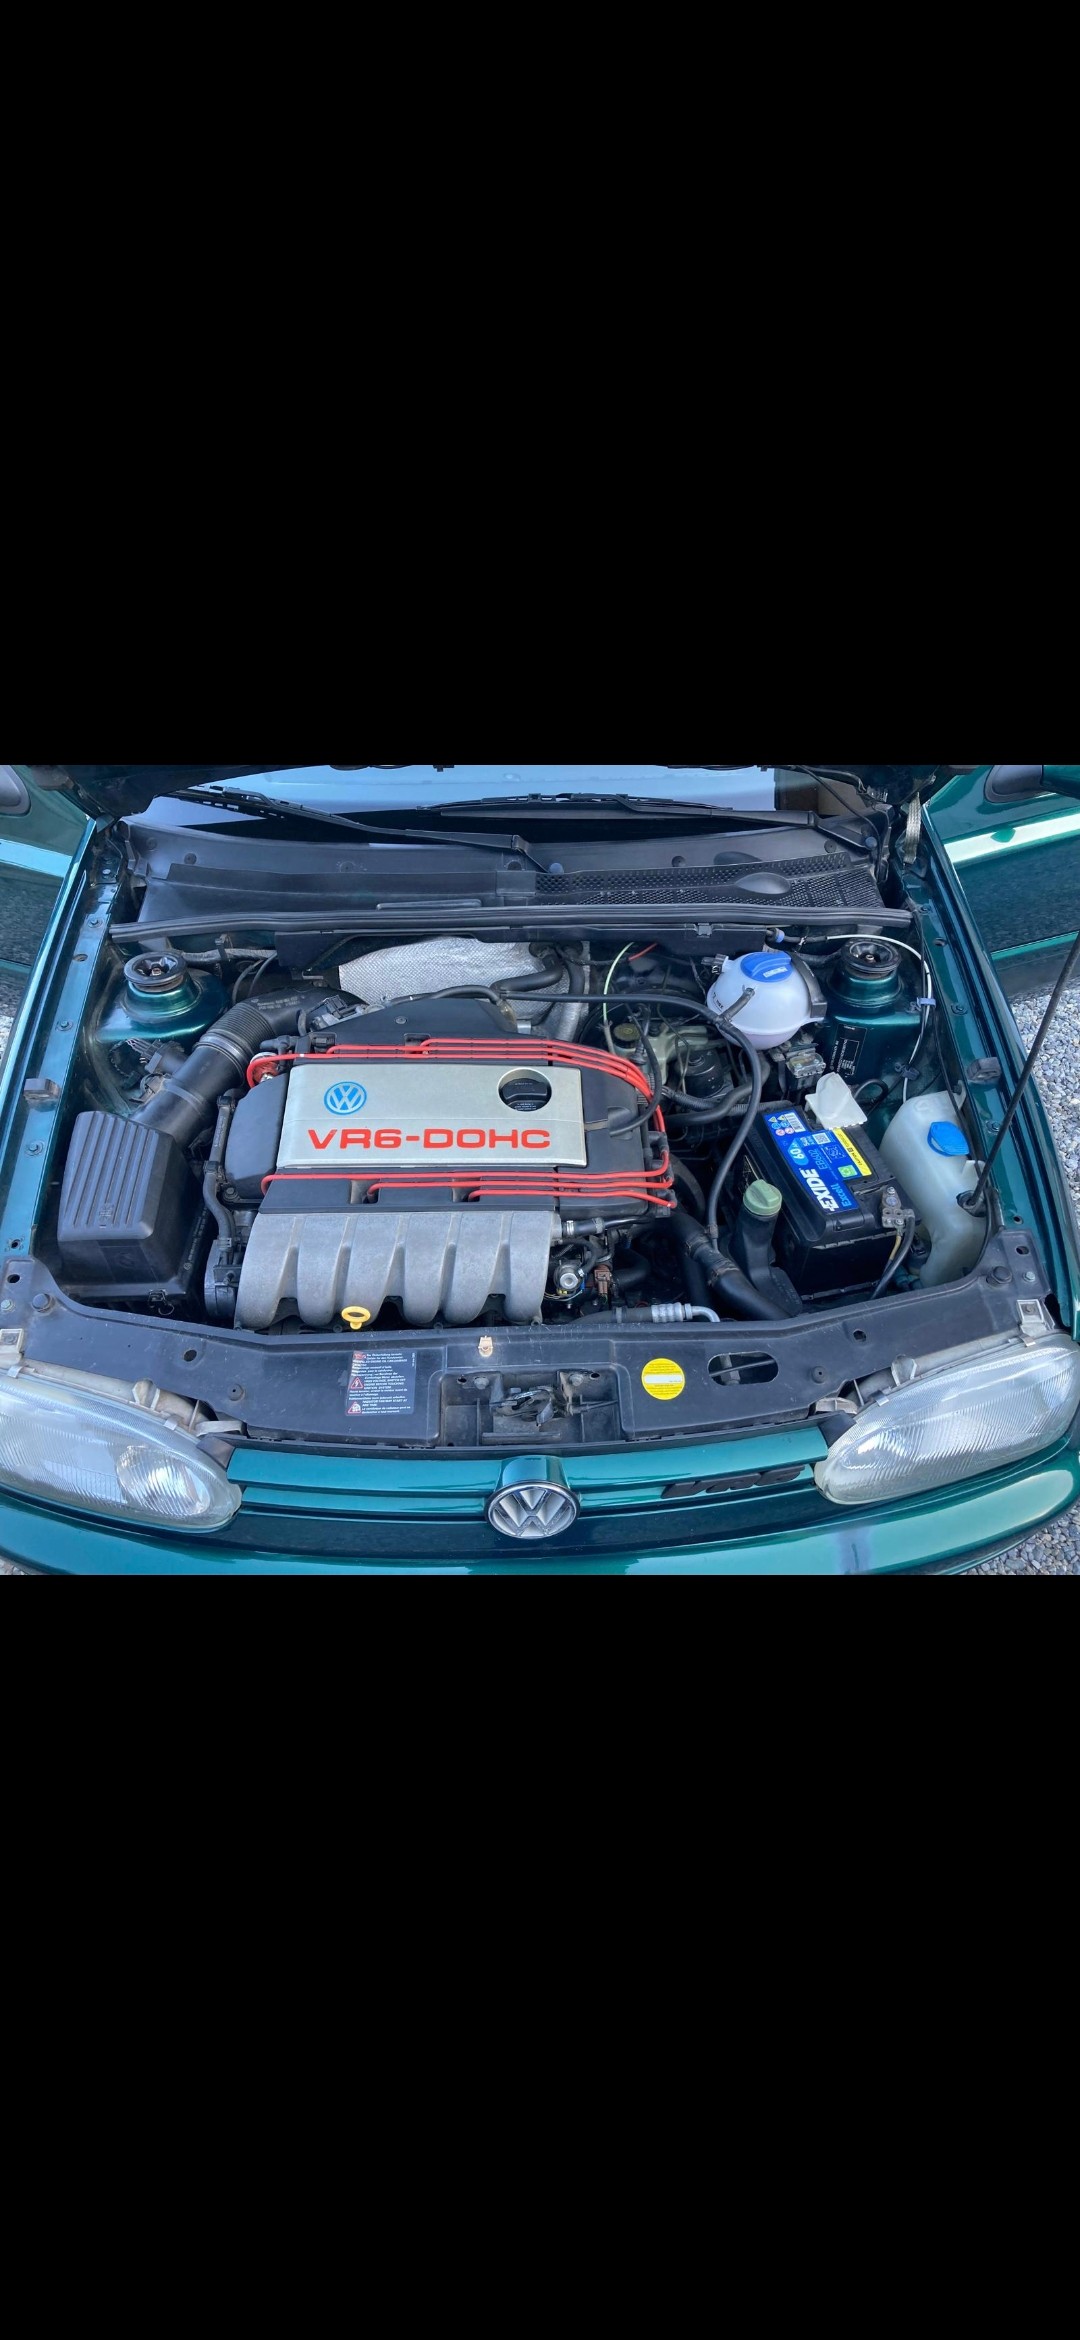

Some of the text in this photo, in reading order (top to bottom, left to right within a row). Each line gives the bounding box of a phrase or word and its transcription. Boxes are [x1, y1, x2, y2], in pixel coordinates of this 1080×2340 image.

[326, 1083, 365, 1113] VW
[308, 1128, 550, 1149] VR6-DOHC
[790, 1148, 805, 1159] 60
[808, 1149, 828, 1169] EB602
[800, 1168, 839, 1212] EXIDE
[831, 1183, 852, 1207] Excell
[492, 1484, 576, 1538] VW
